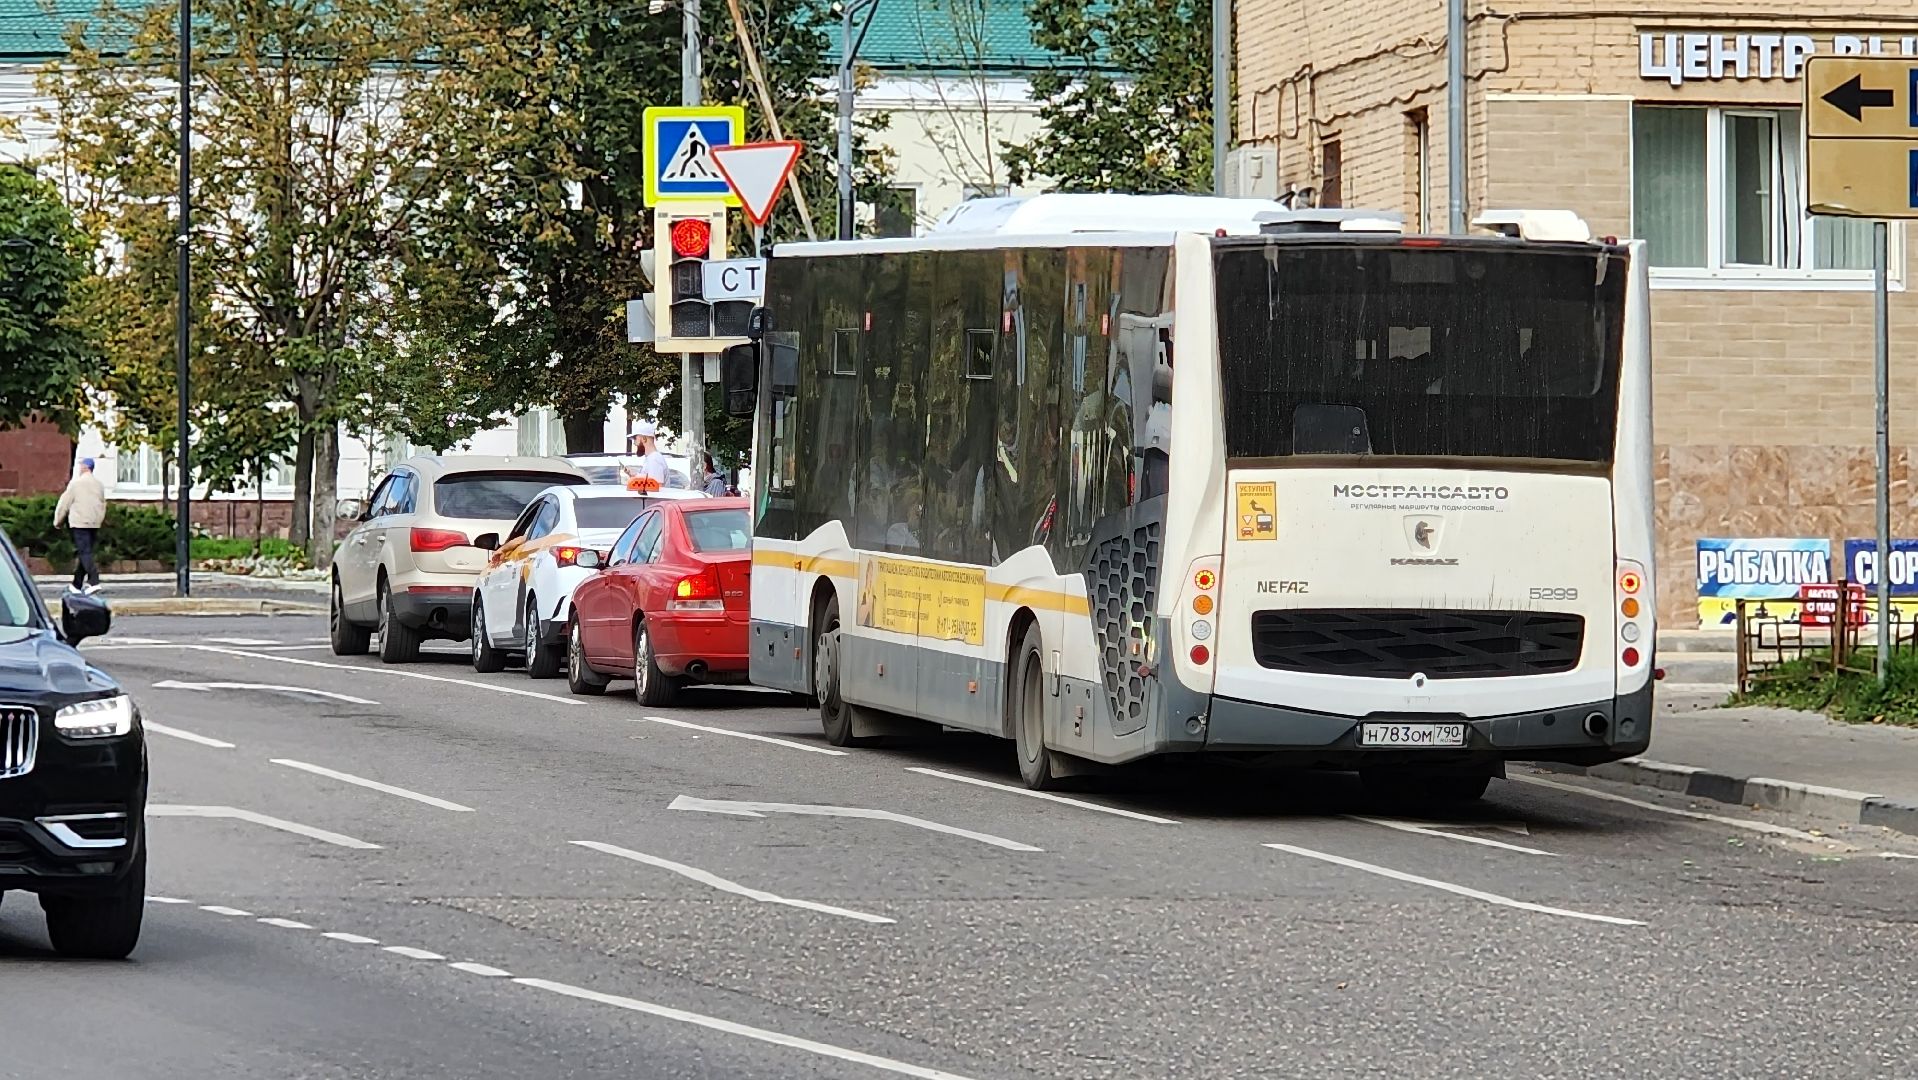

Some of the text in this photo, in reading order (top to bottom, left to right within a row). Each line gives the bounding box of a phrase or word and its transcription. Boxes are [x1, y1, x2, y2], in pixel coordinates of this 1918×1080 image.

[1640, 34, 1815, 85] ЦЕНТР
[1333, 484, 1509, 500] МОСТРАНСАВТО
[1700, 550, 1829, 584] РЫБАЛКА
[1257, 580, 1309, 594] NEFAZ
[1529, 587, 1578, 601] 5299
[1436, 726, 1460, 738] 790
